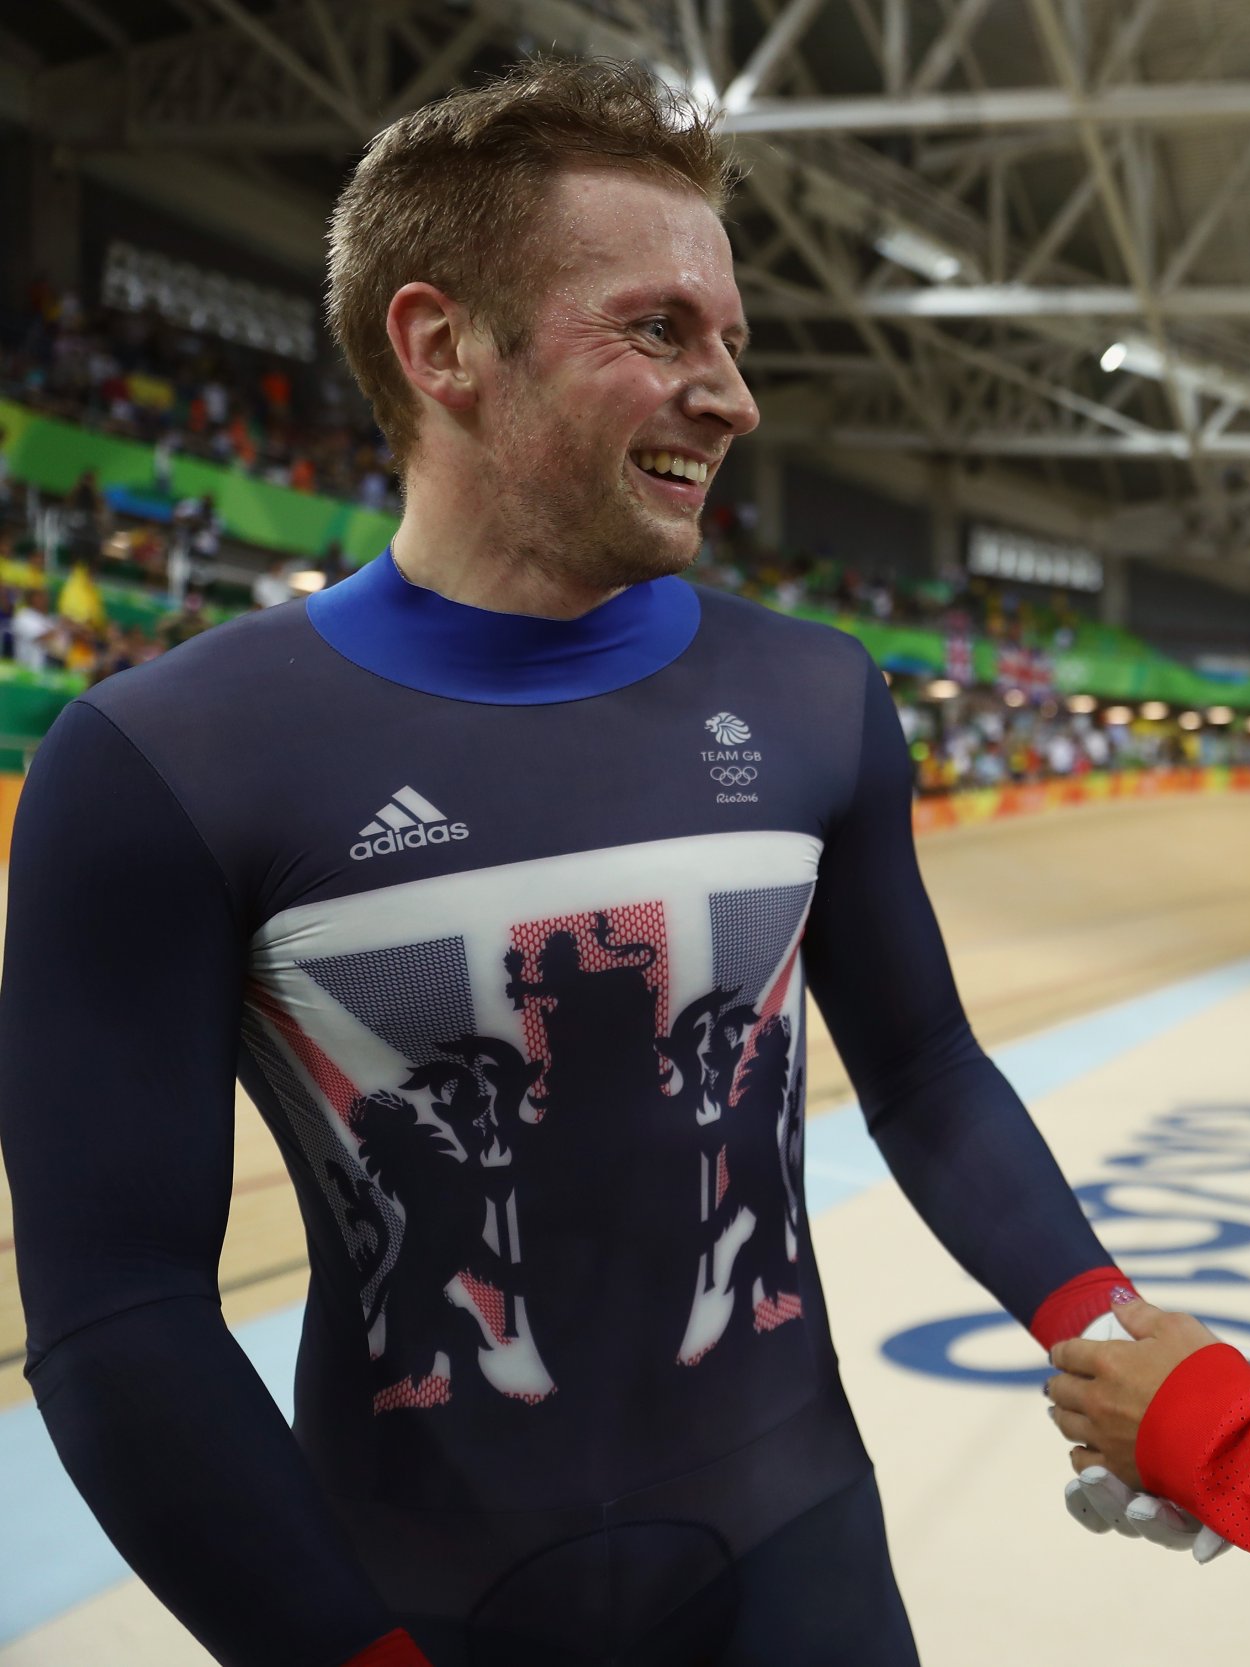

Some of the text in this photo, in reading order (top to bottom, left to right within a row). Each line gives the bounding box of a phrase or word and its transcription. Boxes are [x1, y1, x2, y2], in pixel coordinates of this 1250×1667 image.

[700, 750, 762, 762] TEAM GB
[716, 792, 759, 804] Rio2016
[349, 822, 470, 861] adidas
